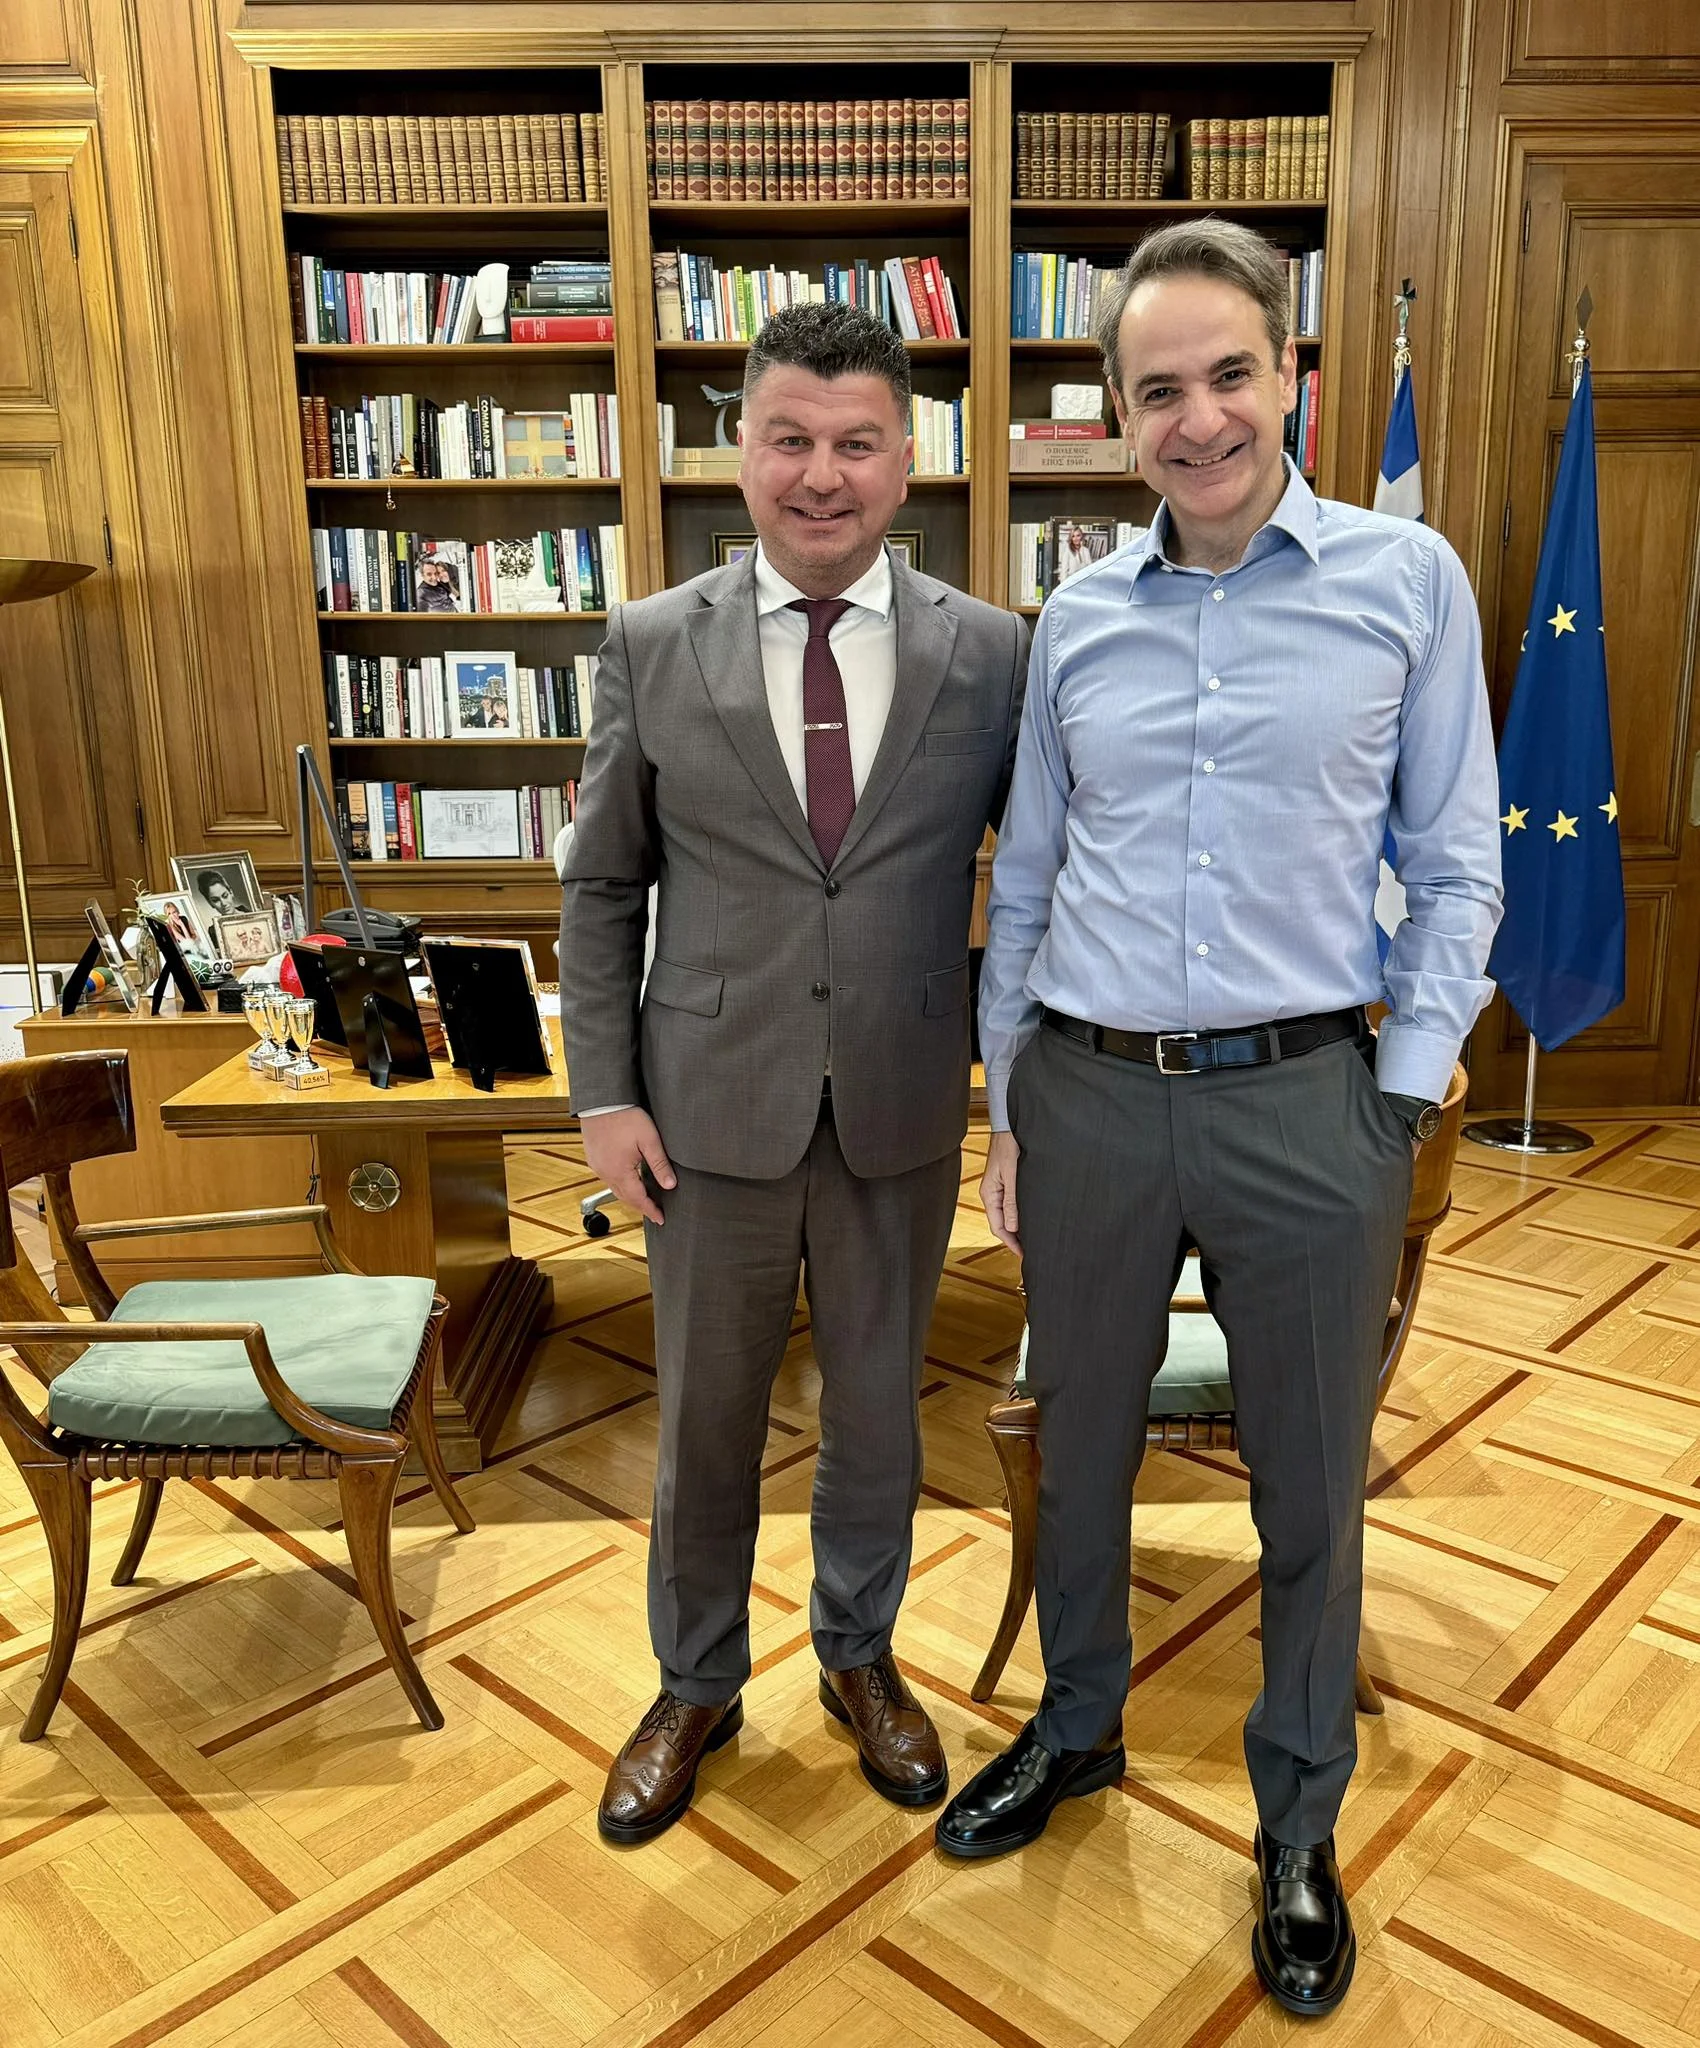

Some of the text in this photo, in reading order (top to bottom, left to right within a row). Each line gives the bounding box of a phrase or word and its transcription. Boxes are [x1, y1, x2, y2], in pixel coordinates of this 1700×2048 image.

[909, 266, 927, 307] ATHENS
[481, 400, 491, 448] COMMAND
[1309, 395, 1318, 425] Sapiens
[367, 555, 375, 592] REVOLUTION
[384, 671, 396, 710] GREEKS
